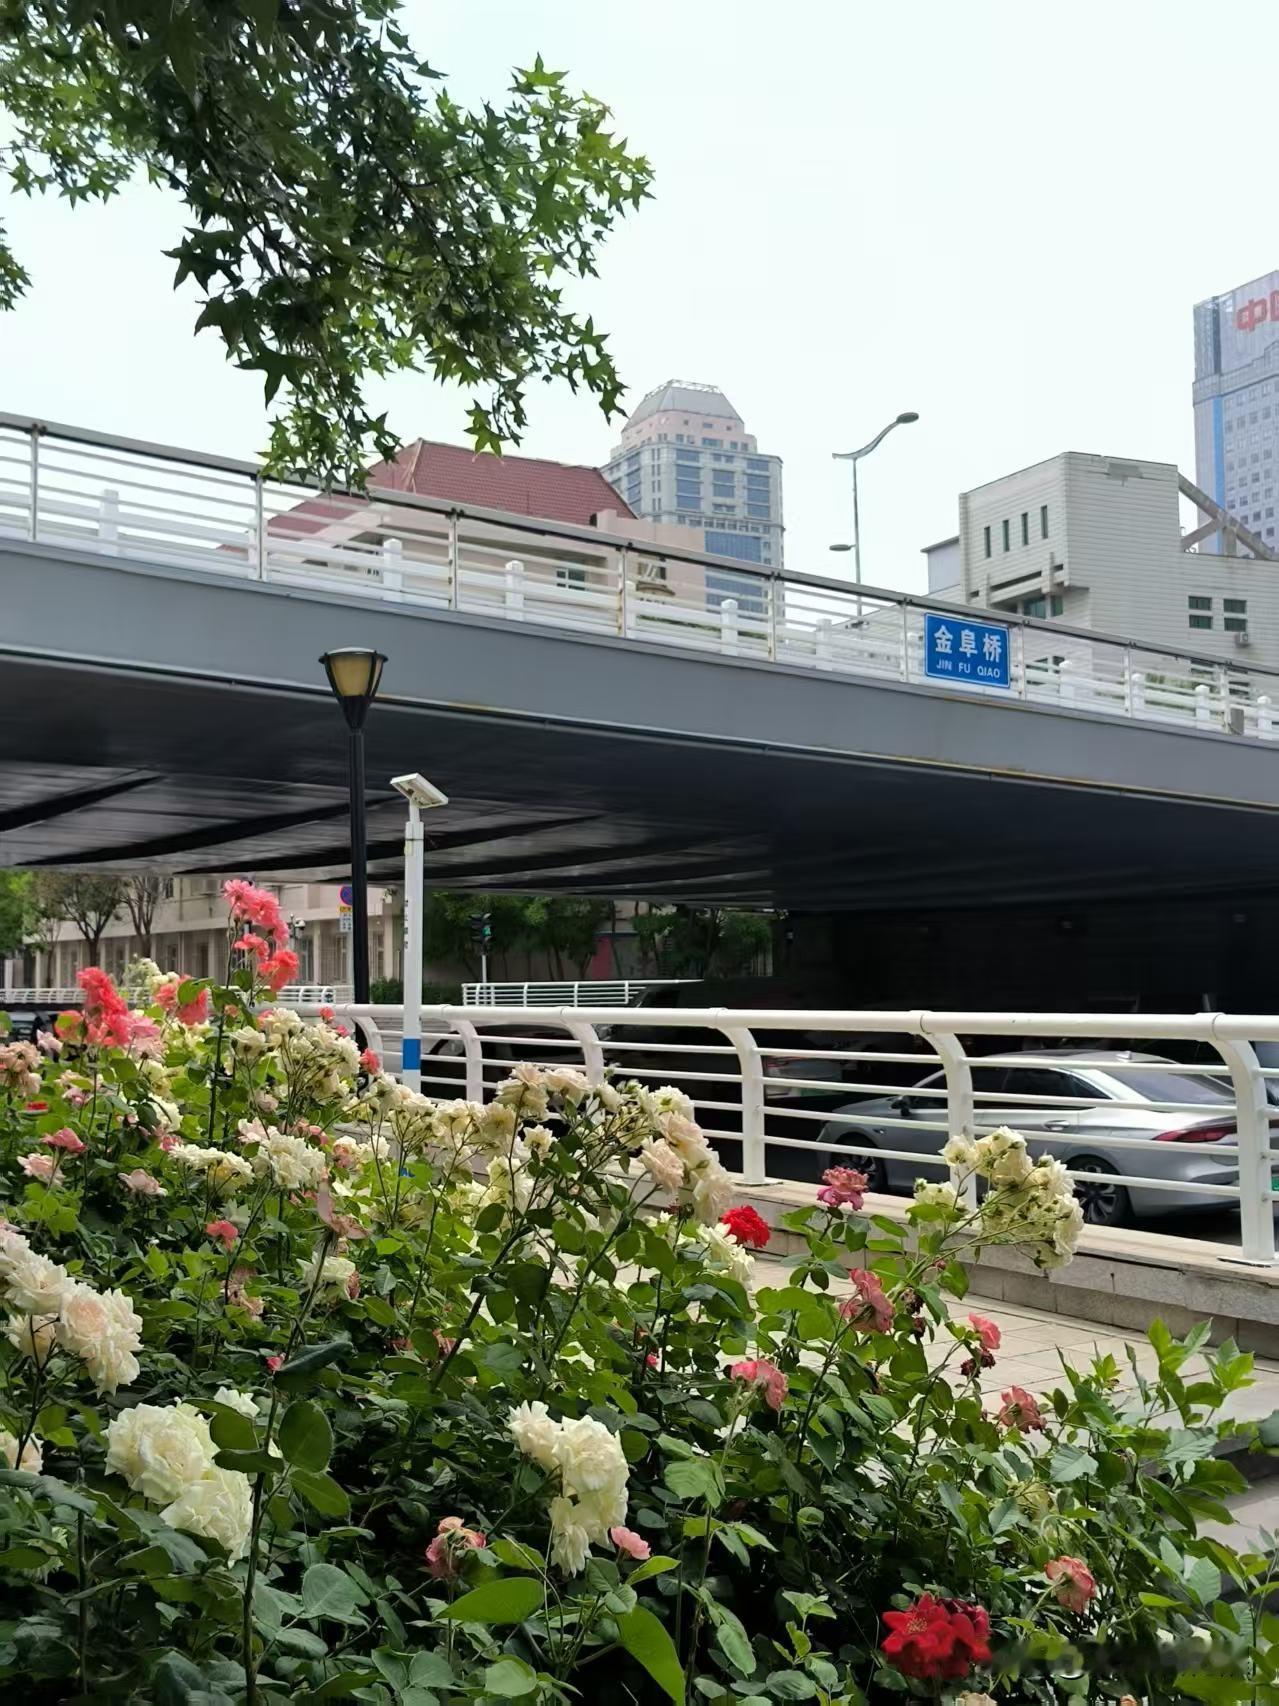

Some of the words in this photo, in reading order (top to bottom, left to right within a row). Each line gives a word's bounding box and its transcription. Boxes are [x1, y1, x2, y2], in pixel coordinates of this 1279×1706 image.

[1236, 289, 1279, 332] 中
[934, 624, 1002, 663] 金阜桥
[936, 659, 953, 671] JIN
[958, 662, 971, 674] FU
[977, 665, 1001, 679] QIAO
